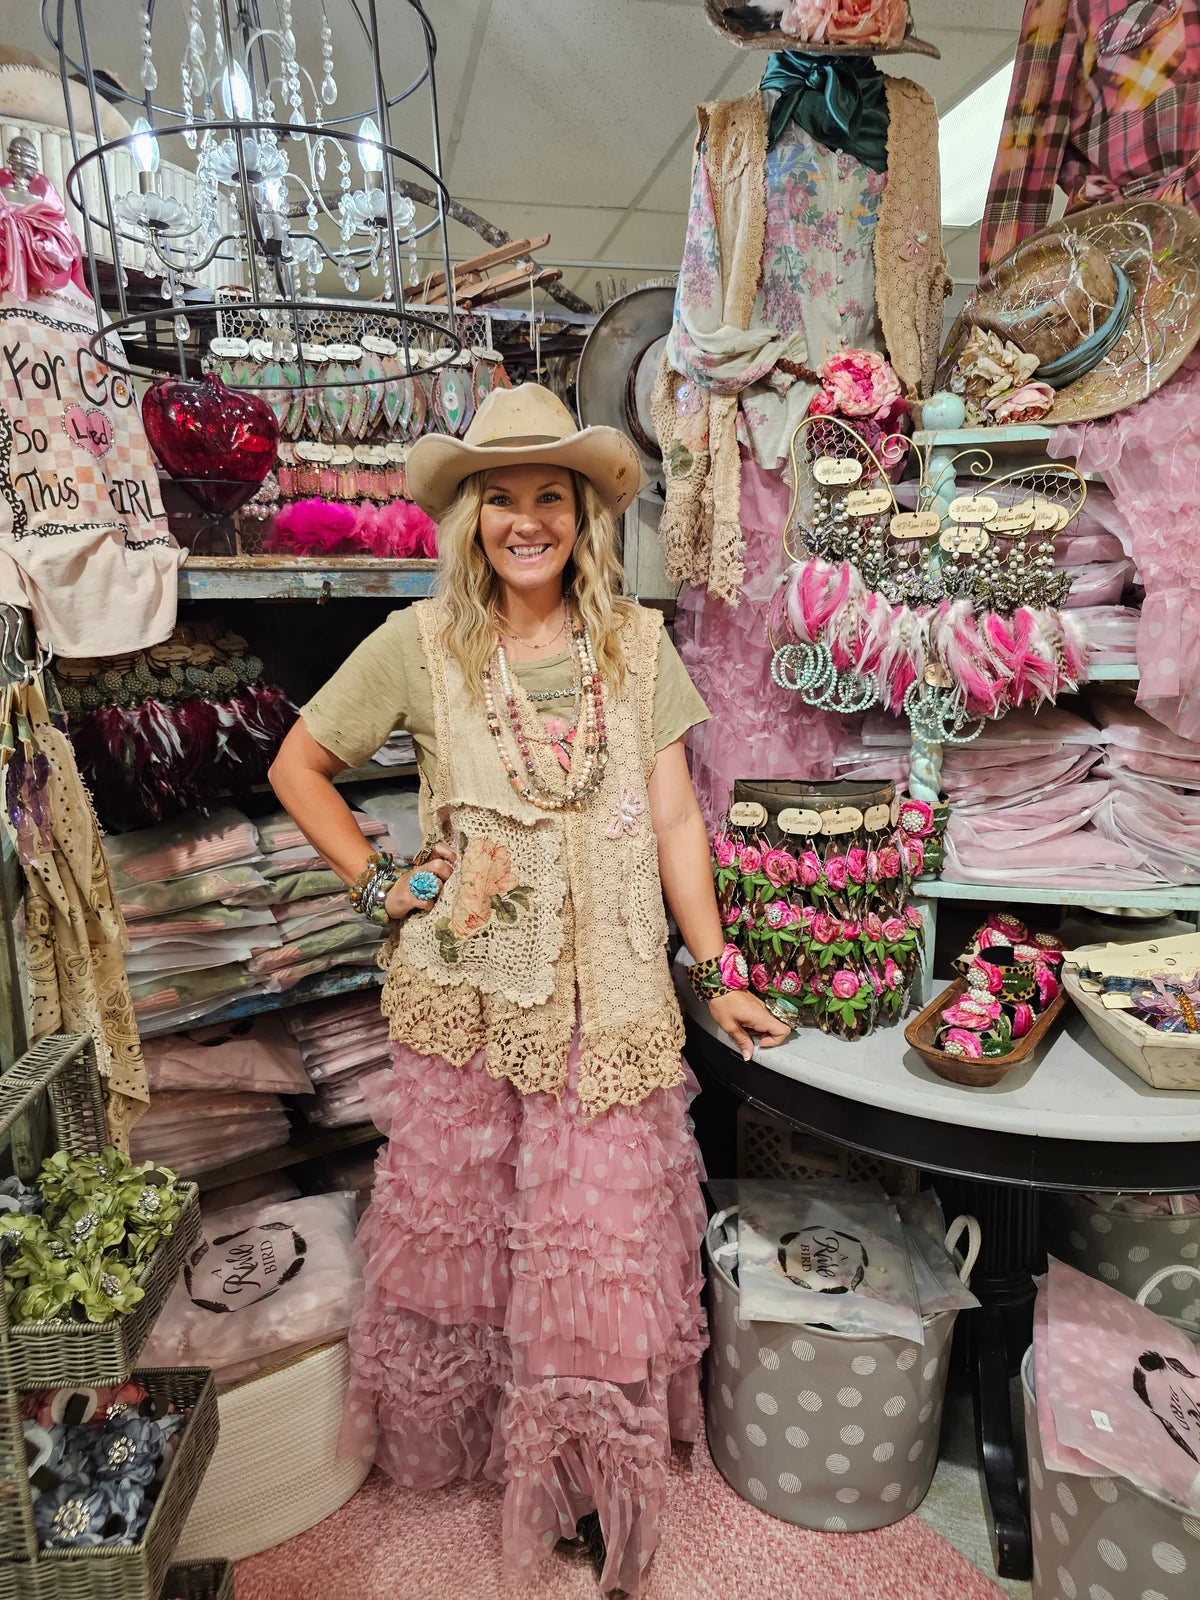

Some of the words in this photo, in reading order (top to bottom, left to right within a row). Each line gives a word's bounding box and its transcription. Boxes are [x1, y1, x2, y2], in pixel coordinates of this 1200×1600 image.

[3, 341, 65, 401] For
[77, 347, 133, 408] Go
[13, 419, 48, 456] So
[71, 418, 109, 445] Led
[15, 466, 79, 513] This
[211, 1268, 224, 1279] A
[260, 1239, 278, 1276] BIRD
[800, 1243, 812, 1273] BIRD
[812, 1235, 840, 1278] Rare
[839, 1252, 849, 1262] A
